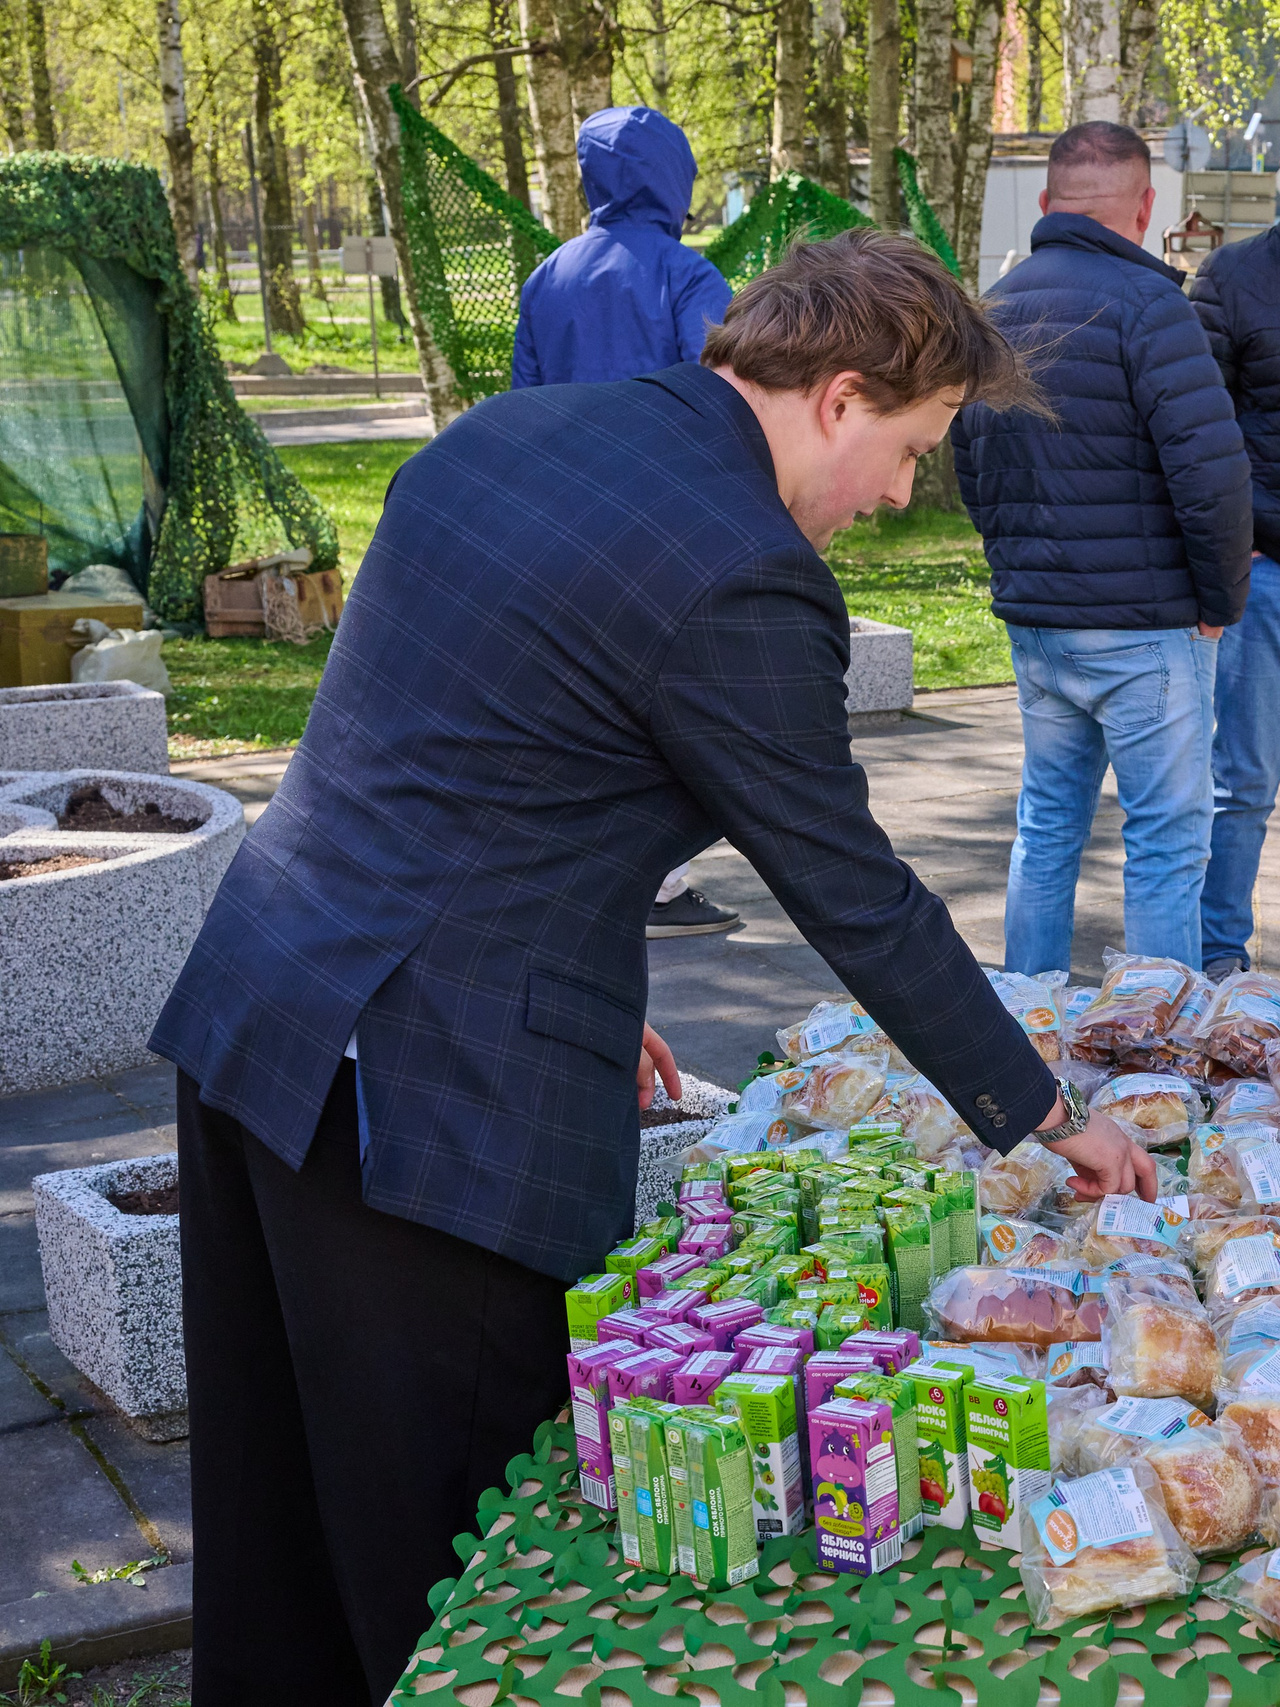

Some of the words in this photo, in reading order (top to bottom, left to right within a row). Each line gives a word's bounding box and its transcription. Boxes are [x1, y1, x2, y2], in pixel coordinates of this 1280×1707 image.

[934, 1388, 940, 1398] 6
[918, 1404, 946, 1417] ЛОКО
[997, 1399, 1004, 1410] 6
[918, 1416, 947, 1429] ОГРАД
[969, 1412, 1009, 1430] ЯБЛОКО
[969, 1424, 1010, 1442] ВИНОГРАД
[652, 1477, 662, 1509] ЯБЛОКО
[709, 1489, 719, 1522] ЯБЛОКО
[853, 1504, 859, 1514] 5
[821, 1534, 865, 1552] ЯБЛОКО
[821, 1546, 866, 1564] ЧЕРНИКА
[822, 1560, 834, 1569] ВВ
